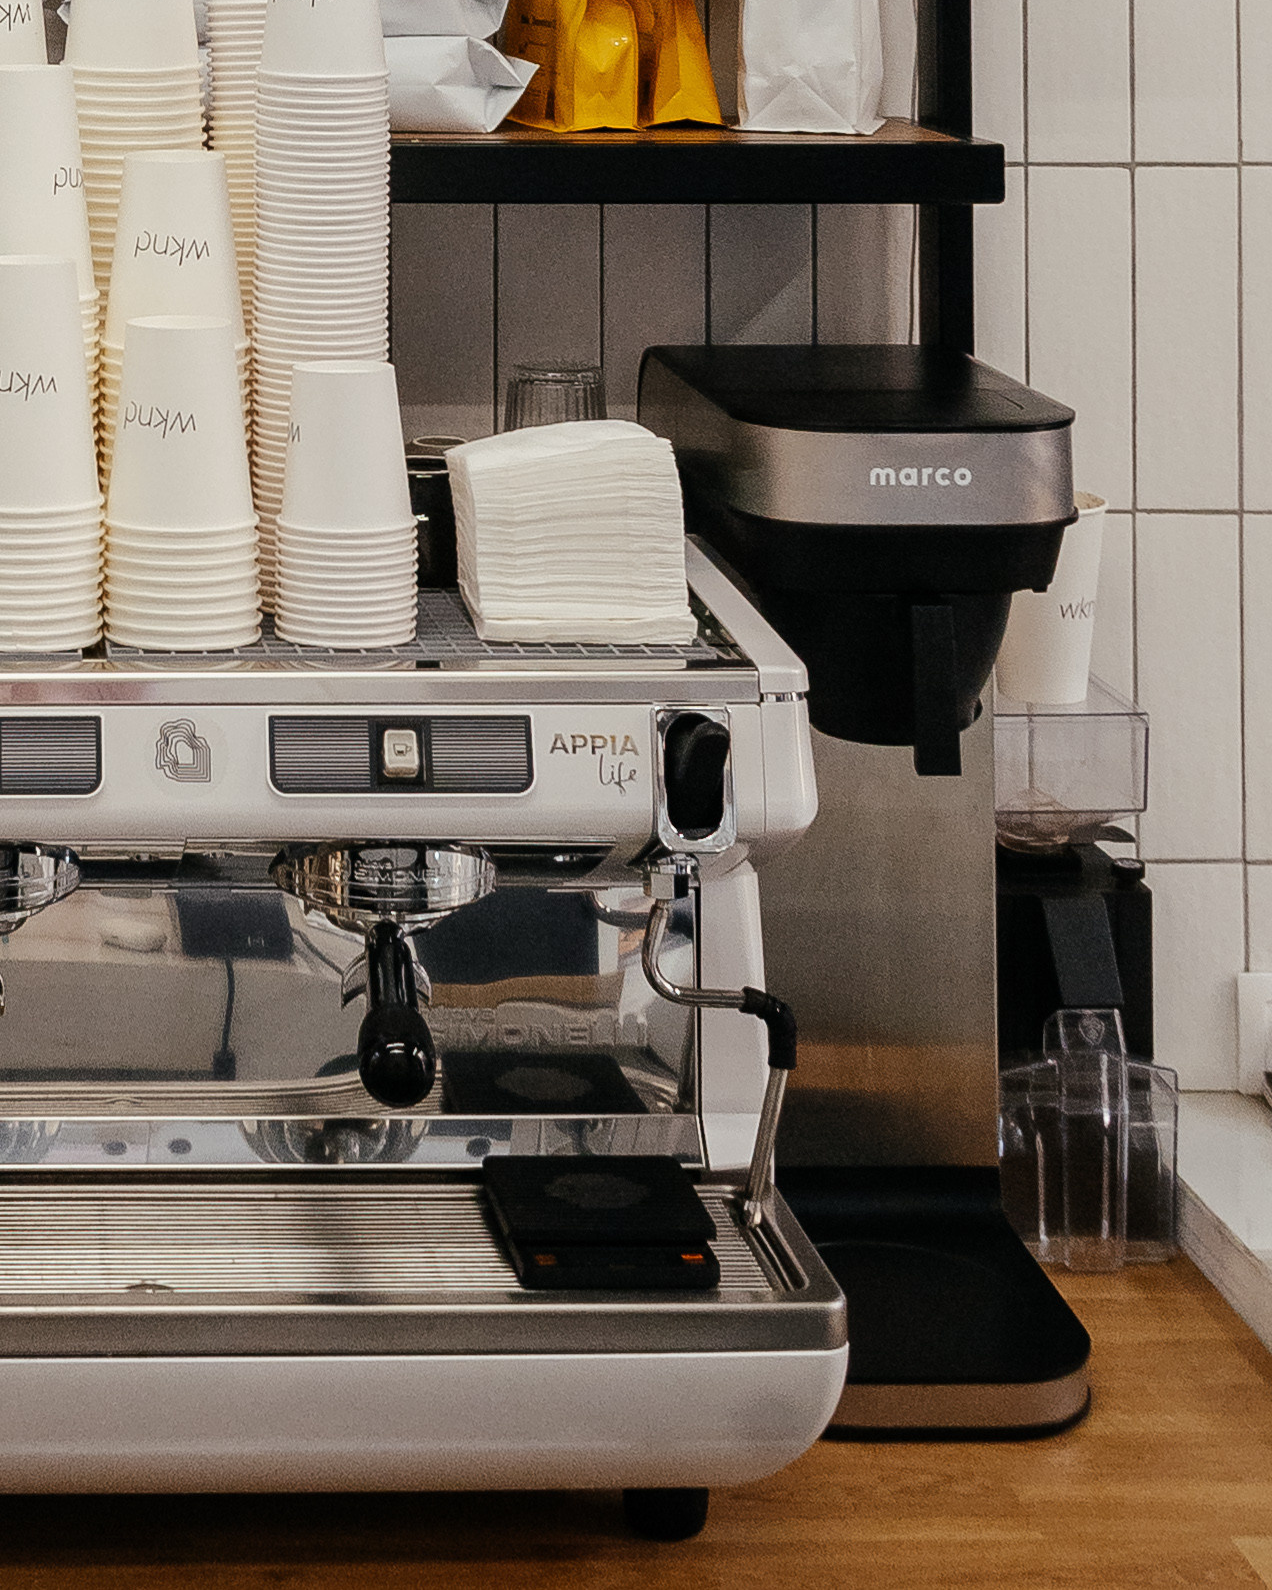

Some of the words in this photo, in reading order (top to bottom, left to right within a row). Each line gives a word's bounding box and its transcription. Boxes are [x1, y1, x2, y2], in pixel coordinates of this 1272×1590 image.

[134, 230, 210, 266] wknd
[124, 401, 197, 439] wknd
[870, 467, 972, 486] marco
[549, 733, 640, 756] APPIA
[598, 753, 637, 798] life
